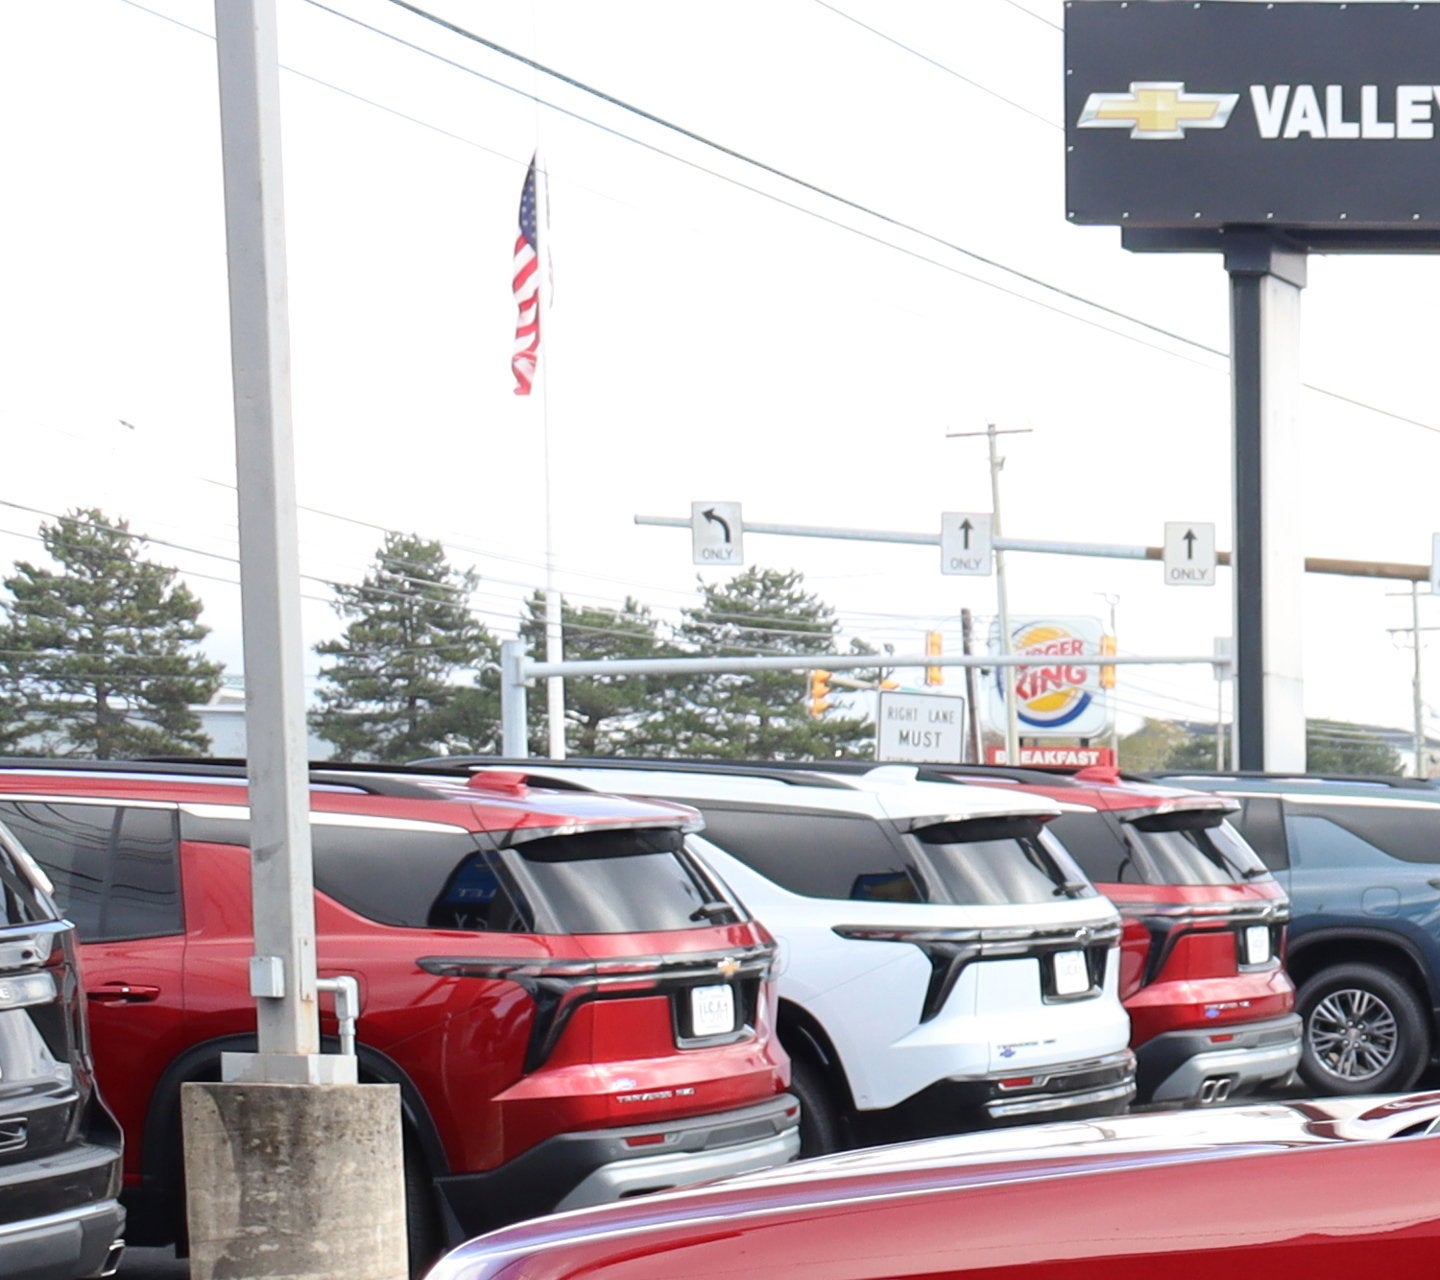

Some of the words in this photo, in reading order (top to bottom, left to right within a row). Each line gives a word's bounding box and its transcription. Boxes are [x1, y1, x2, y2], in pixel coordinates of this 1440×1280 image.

[702, 548, 733, 560] ONLY
[950, 556, 983, 570] ONLY
[1170, 567, 1208, 580] ONLY
[887, 706, 918, 721] RIGHT
[928, 709, 956, 725] LANE
[899, 728, 942, 748] MUST
[995, 750, 1099, 766] BEAKFAST
